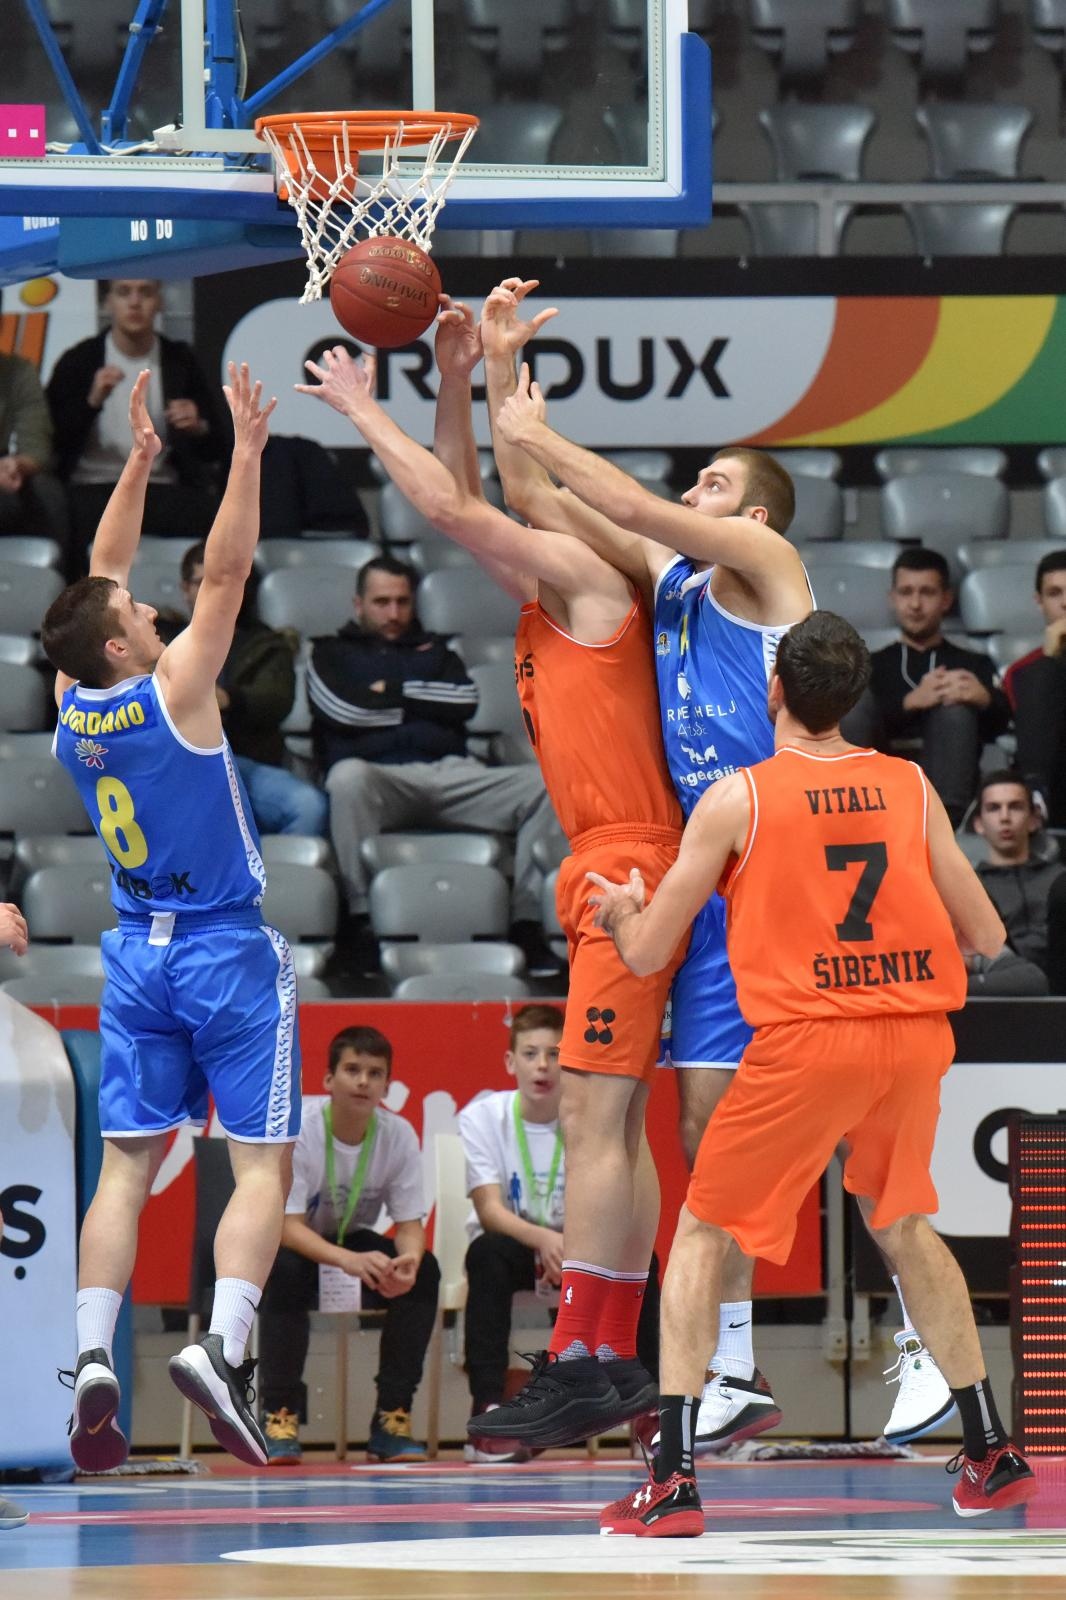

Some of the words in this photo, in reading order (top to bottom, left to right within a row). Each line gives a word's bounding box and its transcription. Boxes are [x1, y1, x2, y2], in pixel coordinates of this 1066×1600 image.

[303, 336, 732, 401] CRDUX
[96, 776, 148, 869] 8
[805, 787, 887, 815] VITALI
[824, 841, 888, 942] 7
[813, 949, 935, 990] ŠIBENIK
